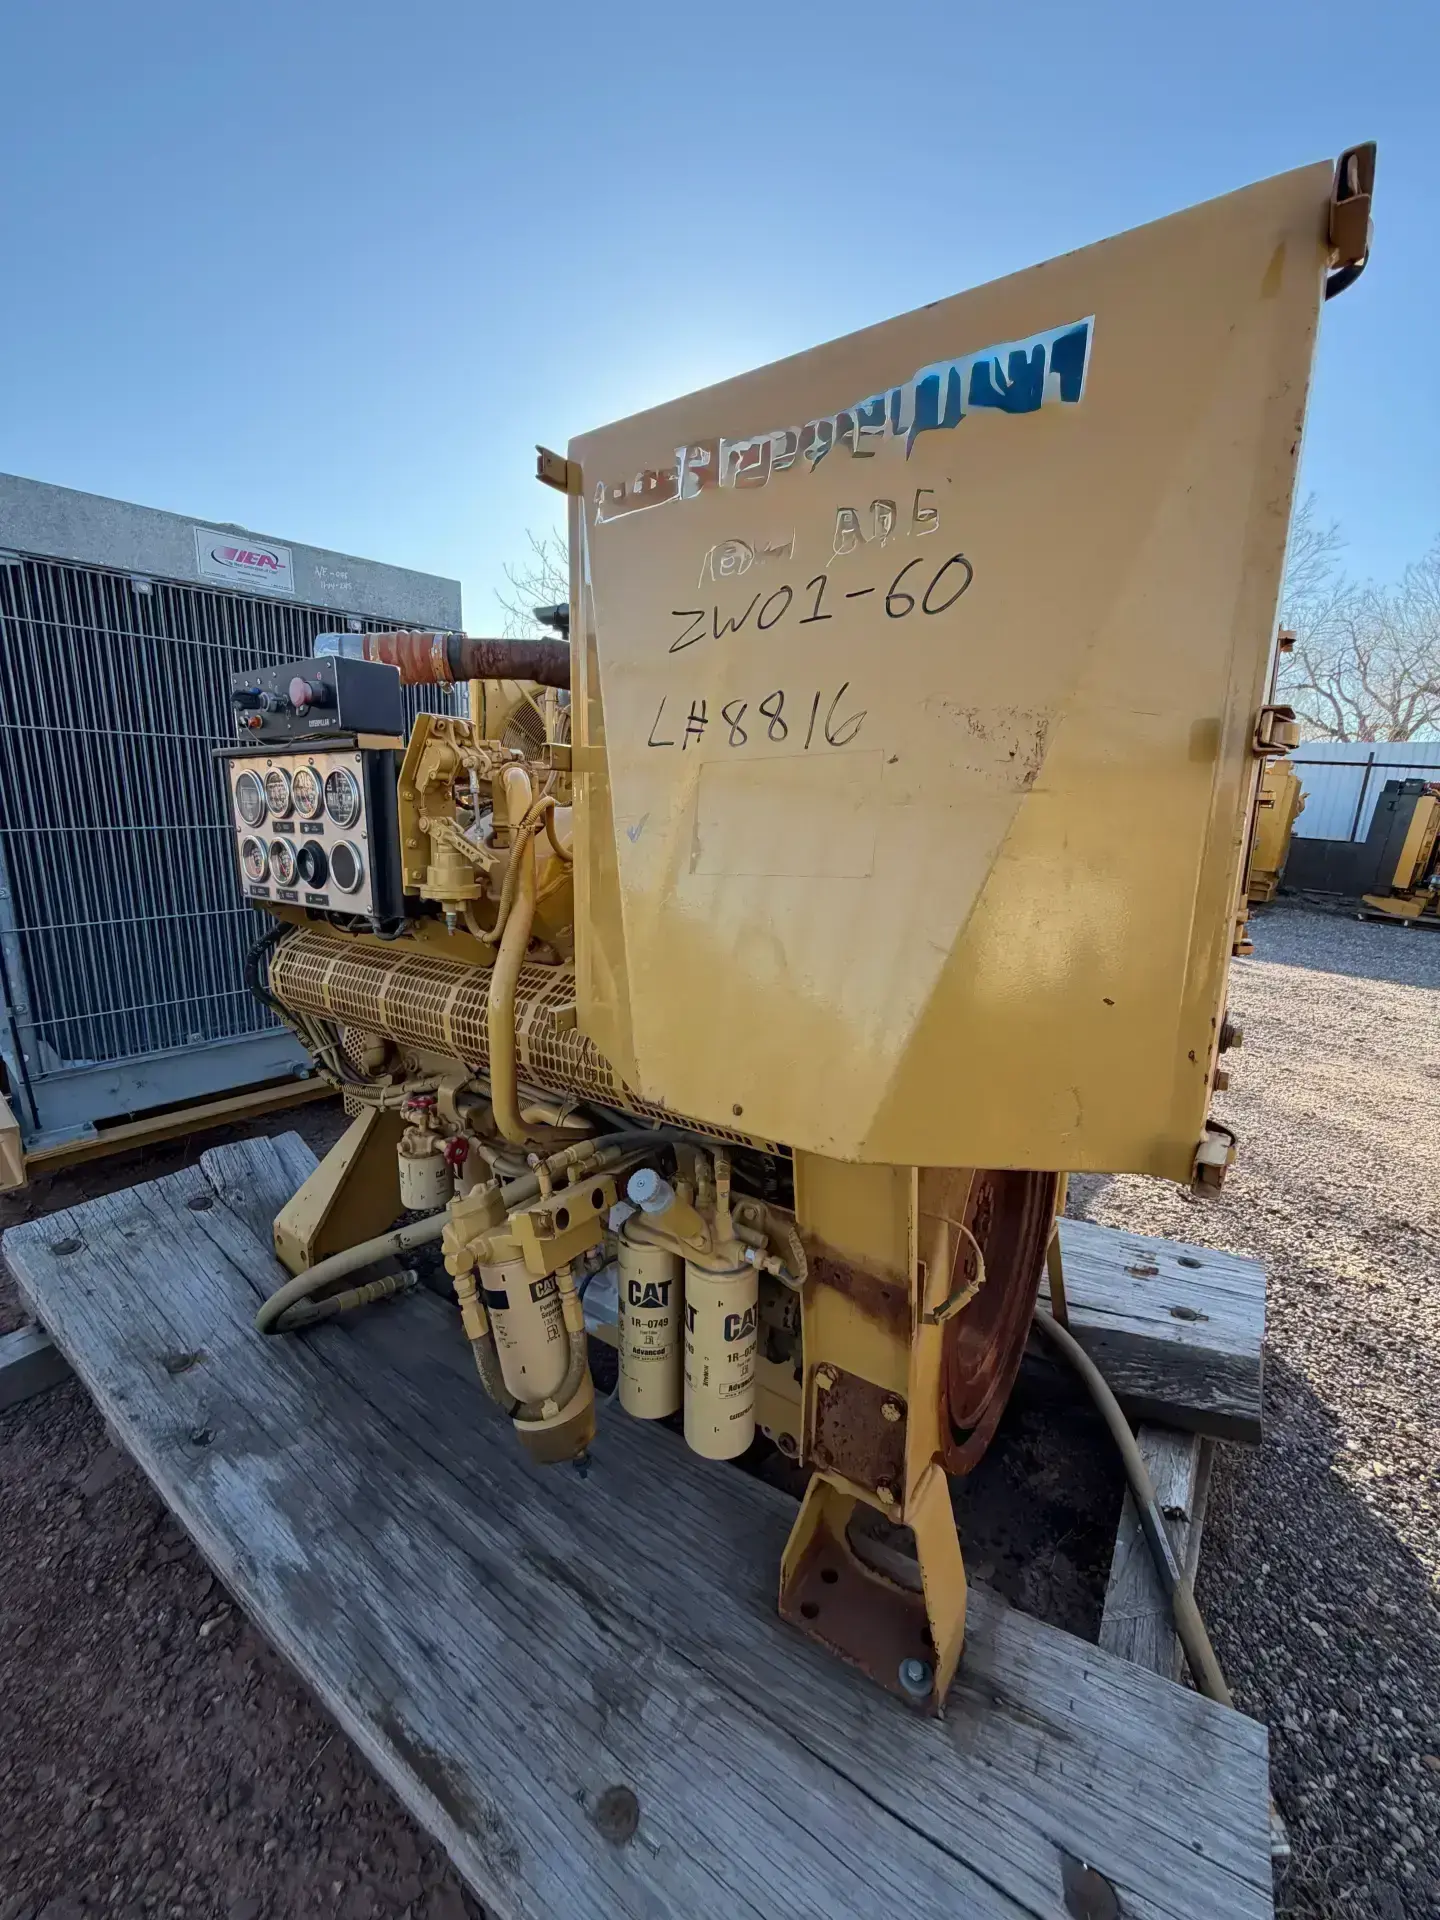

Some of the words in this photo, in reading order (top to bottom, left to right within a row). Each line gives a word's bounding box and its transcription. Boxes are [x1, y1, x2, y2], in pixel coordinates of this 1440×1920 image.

[235, 550, 285, 570] IEA
[648, 682, 868, 751] L#8816
[535, 1276, 557, 1298] CAT
[628, 1279, 673, 1309] CAT
[631, 1316, 669, 1329] 1R-0749
[632, 1346, 666, 1356] Advanced
